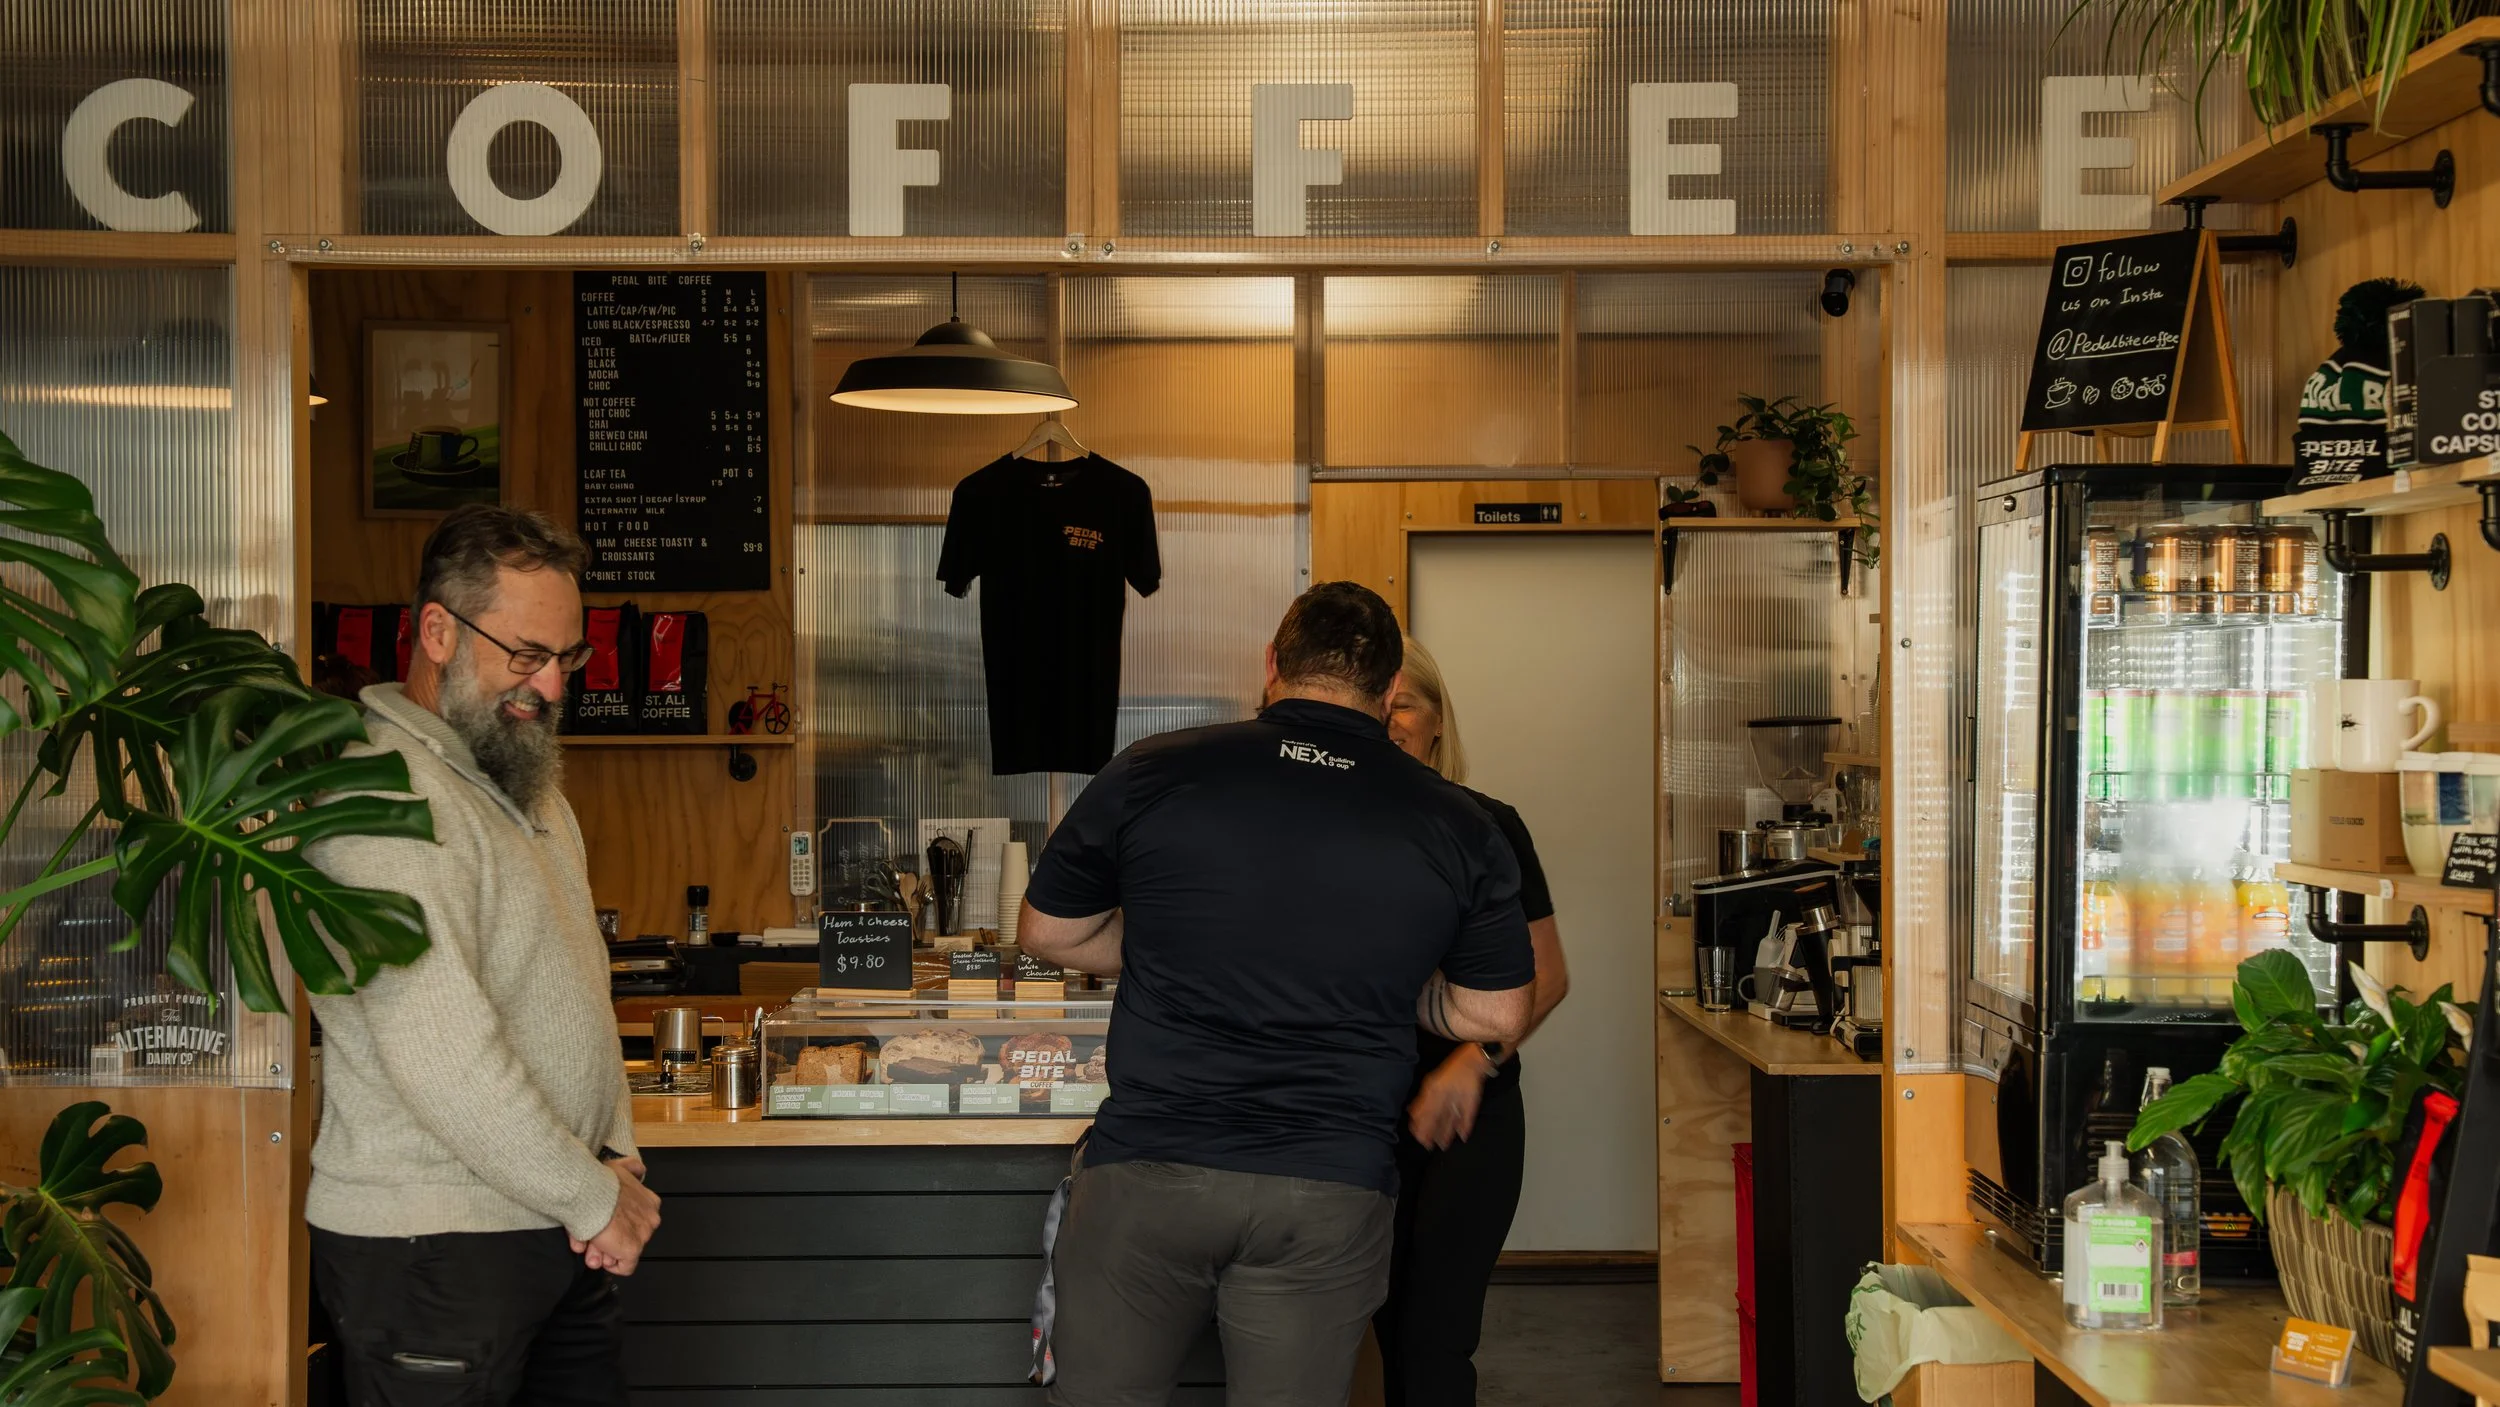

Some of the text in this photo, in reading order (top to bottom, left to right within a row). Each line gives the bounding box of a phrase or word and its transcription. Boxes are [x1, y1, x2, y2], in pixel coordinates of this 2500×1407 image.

[2098, 252, 2160, 282] follow
[612, 275, 712, 286] PEDAL BITE COFFEE
[581, 292, 615, 302] COFFEE
[2061, 287, 2164, 312] us on Insta
[587, 319, 610, 330] LONG
[613, 319, 690, 330] BLACK/ESPRESSO
[582, 336, 601, 347] ICED
[587, 347, 616, 358] LATTE
[588, 358, 616, 369] BLACK
[588, 369, 619, 380] MOCHA
[588, 380, 611, 391] CHOC
[583, 397, 636, 408] NOT COFFEE
[589, 408, 605, 419] HOT
[608, 408, 630, 419] CHOC
[589, 419, 608, 430] CHAI
[589, 430, 625, 441] BREWED
[628, 430, 648, 441] CHAI
[589, 441, 617, 452] CHILLI
[620, 441, 642, 452] CHOC
[2300, 439, 2380, 457] PEDAL
[609, 469, 626, 479] TEA
[722, 468, 739, 478] POT
[584, 482, 606, 490] BABY
[610, 482, 635, 490] CHINO
[646, 496, 673, 504] DECAF
[1477, 511, 1520, 522] Toilets
[584, 521, 649, 532] HOT FOOD
[1063, 526, 1104, 543] PEDAL
[596, 537, 616, 548] HAM
[624, 537, 658, 548] CHEESE
[661, 537, 694, 548] TOASTY
[1068, 537, 1098, 550] BITE
[602, 551, 655, 562] CROISSANTS
[585, 571, 656, 581] CABINET STOCK
[582, 693, 600, 704] ST.
[645, 695, 662, 706] ST.
[579, 705, 629, 717] COFFEE
[642, 707, 691, 719] COFFEE
[1280, 743, 1329, 766] NEX
[1328, 756, 1355, 767] Building
[824, 915, 854, 930] Ham
[836, 931, 891, 945] Toasties
[837, 953, 885, 974] $9.80
[123, 994, 170, 1008] PROUDLY
[114, 1025, 226, 1055] ALTERNATIVE
[146, 1052, 178, 1065] DAIRY
[1009, 1050, 1076, 1064] PEDAL
[1019, 1065, 1065, 1079] BITE
